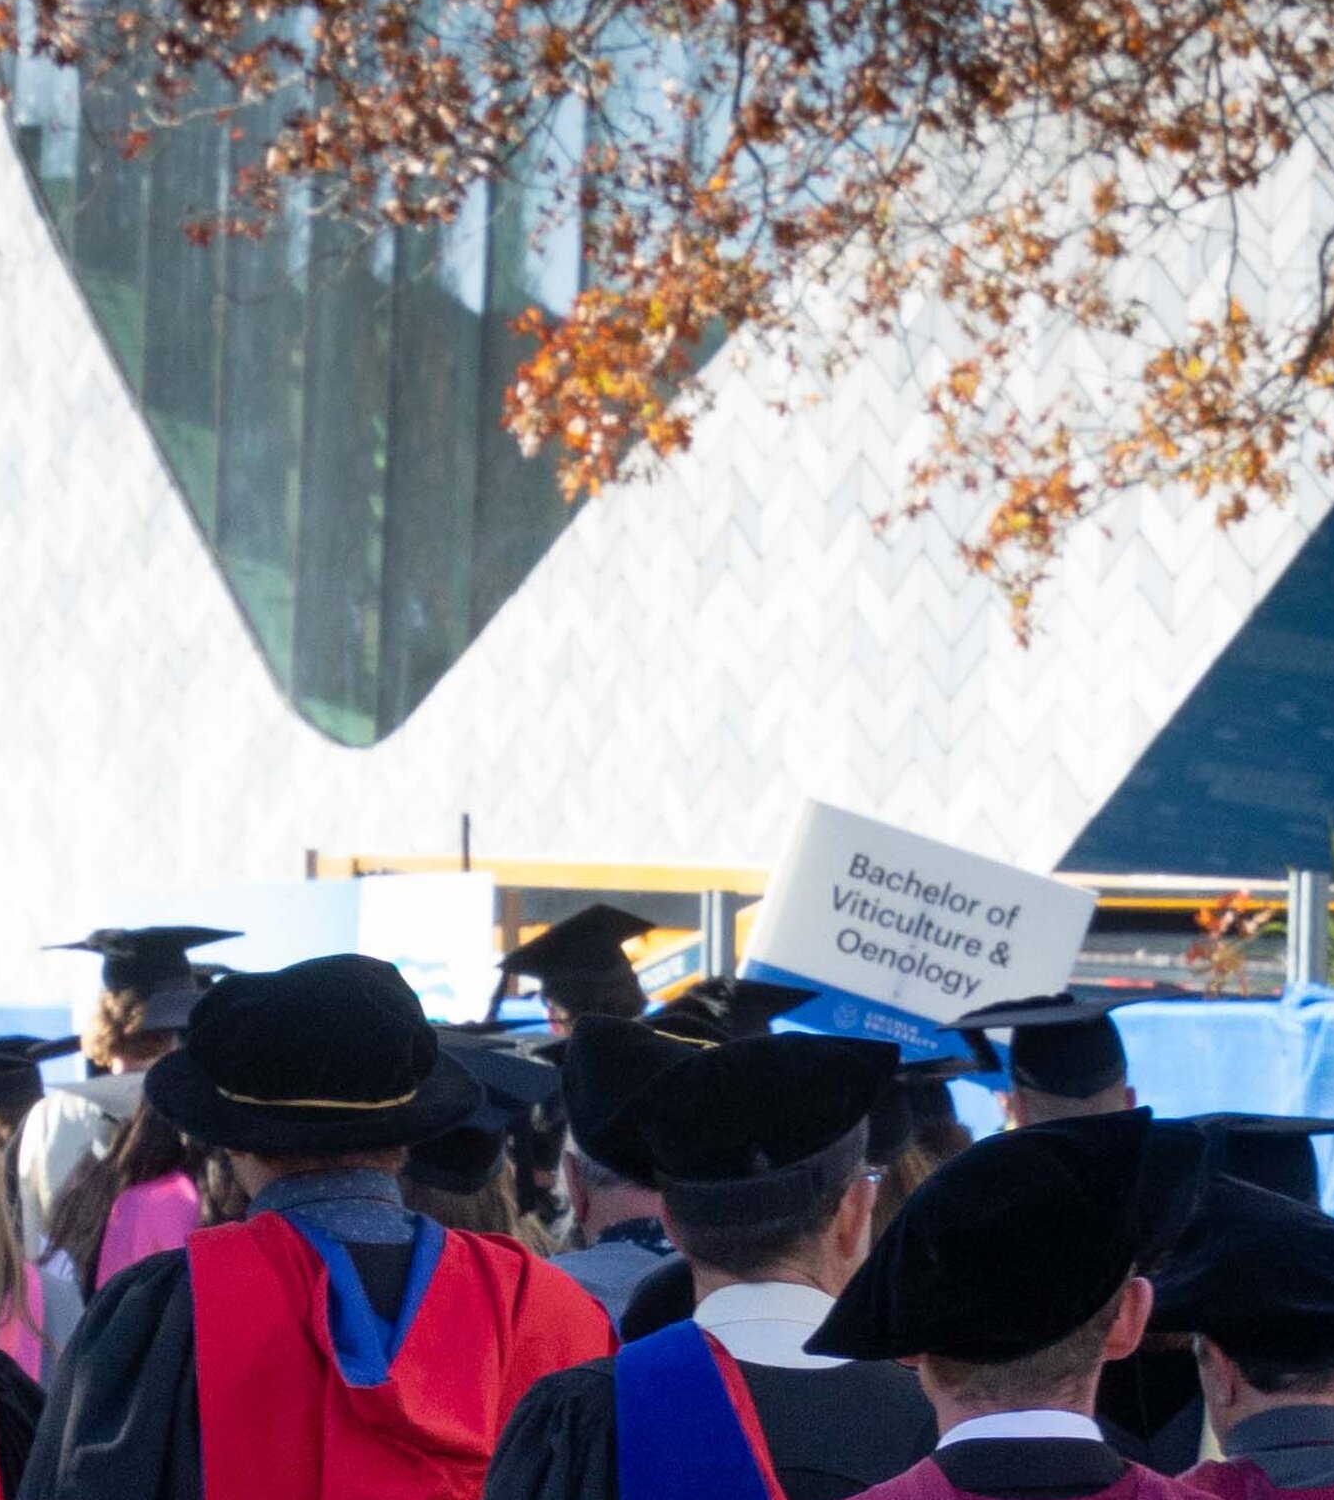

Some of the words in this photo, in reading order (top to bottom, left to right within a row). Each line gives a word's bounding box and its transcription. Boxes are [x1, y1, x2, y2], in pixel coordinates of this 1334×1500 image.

[833, 885, 982, 959] Viticulture
[988, 941, 1011, 968] &
[848, 853, 981, 916] Bachelor
[986, 904, 1020, 930] of
[836, 928, 981, 999] Oenology
